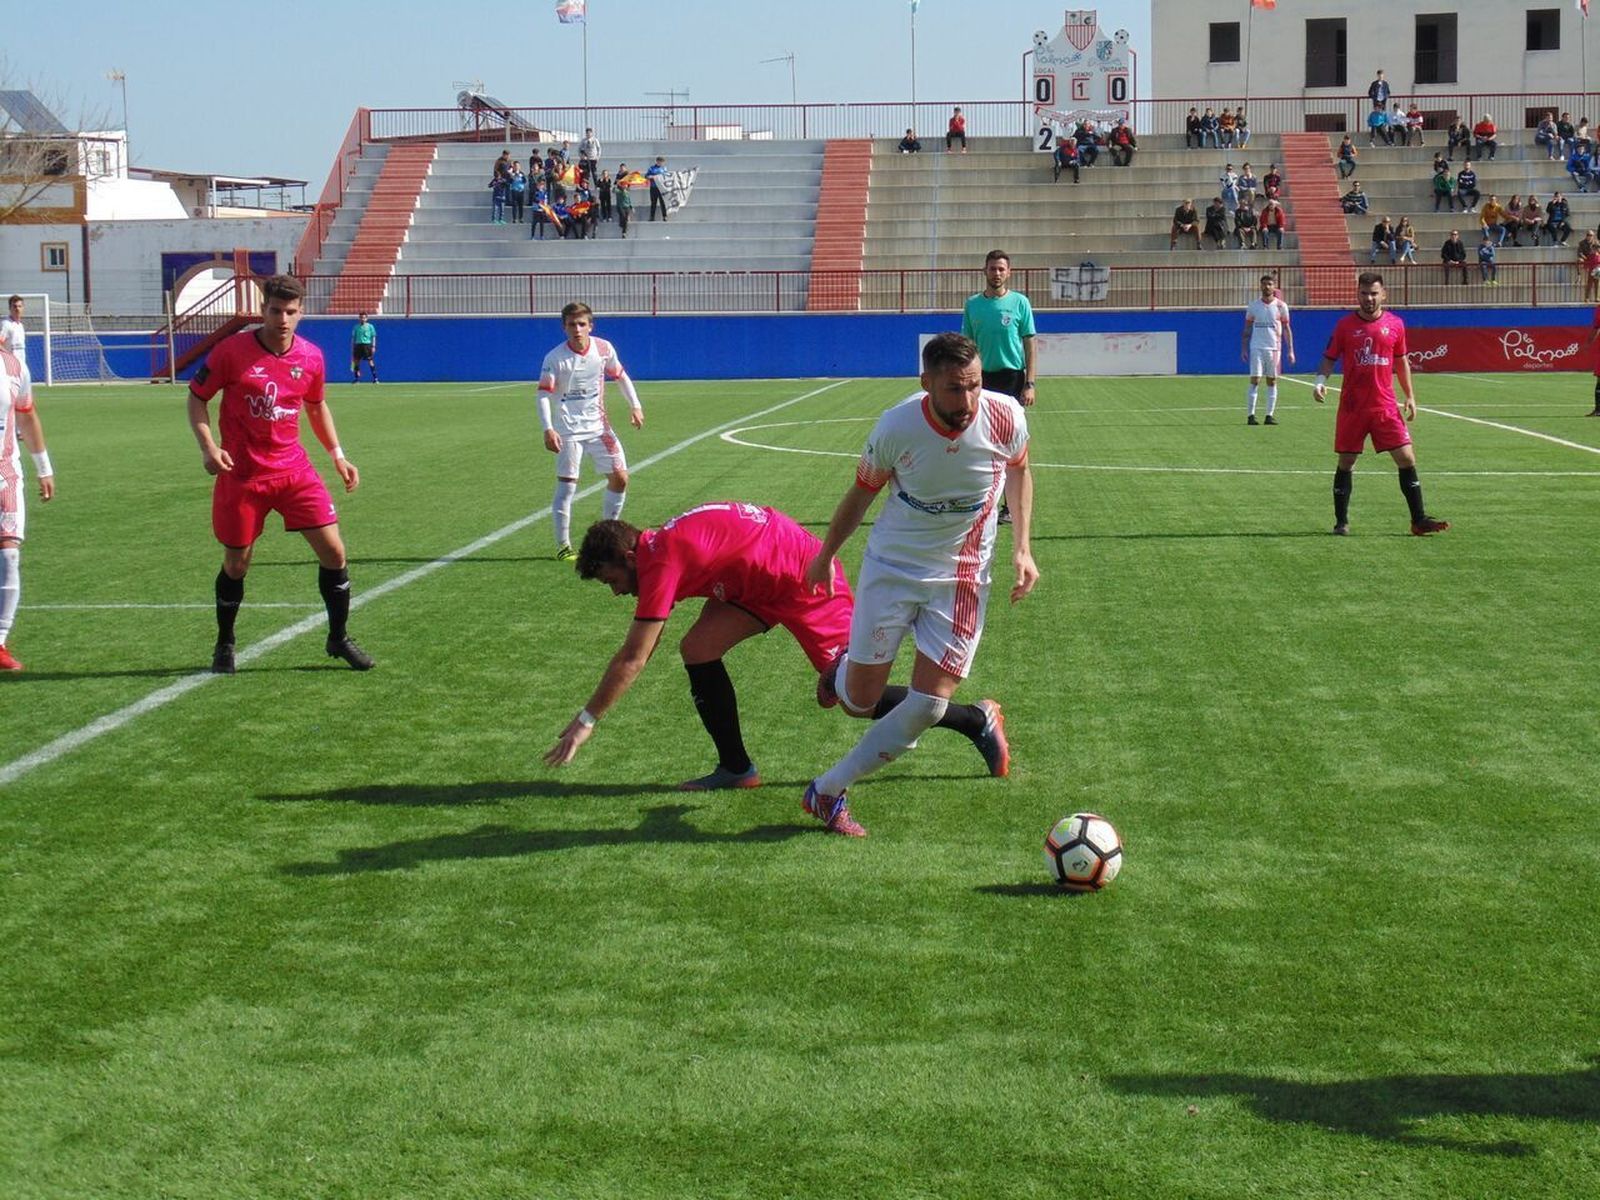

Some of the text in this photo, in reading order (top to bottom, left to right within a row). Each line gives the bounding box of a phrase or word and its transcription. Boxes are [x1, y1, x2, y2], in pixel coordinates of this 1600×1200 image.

[1036, 78, 1051, 102] 0
[1077, 82, 1084, 97] 1
[1111, 77, 1126, 101] 0
[1039, 127, 1053, 151] 2
